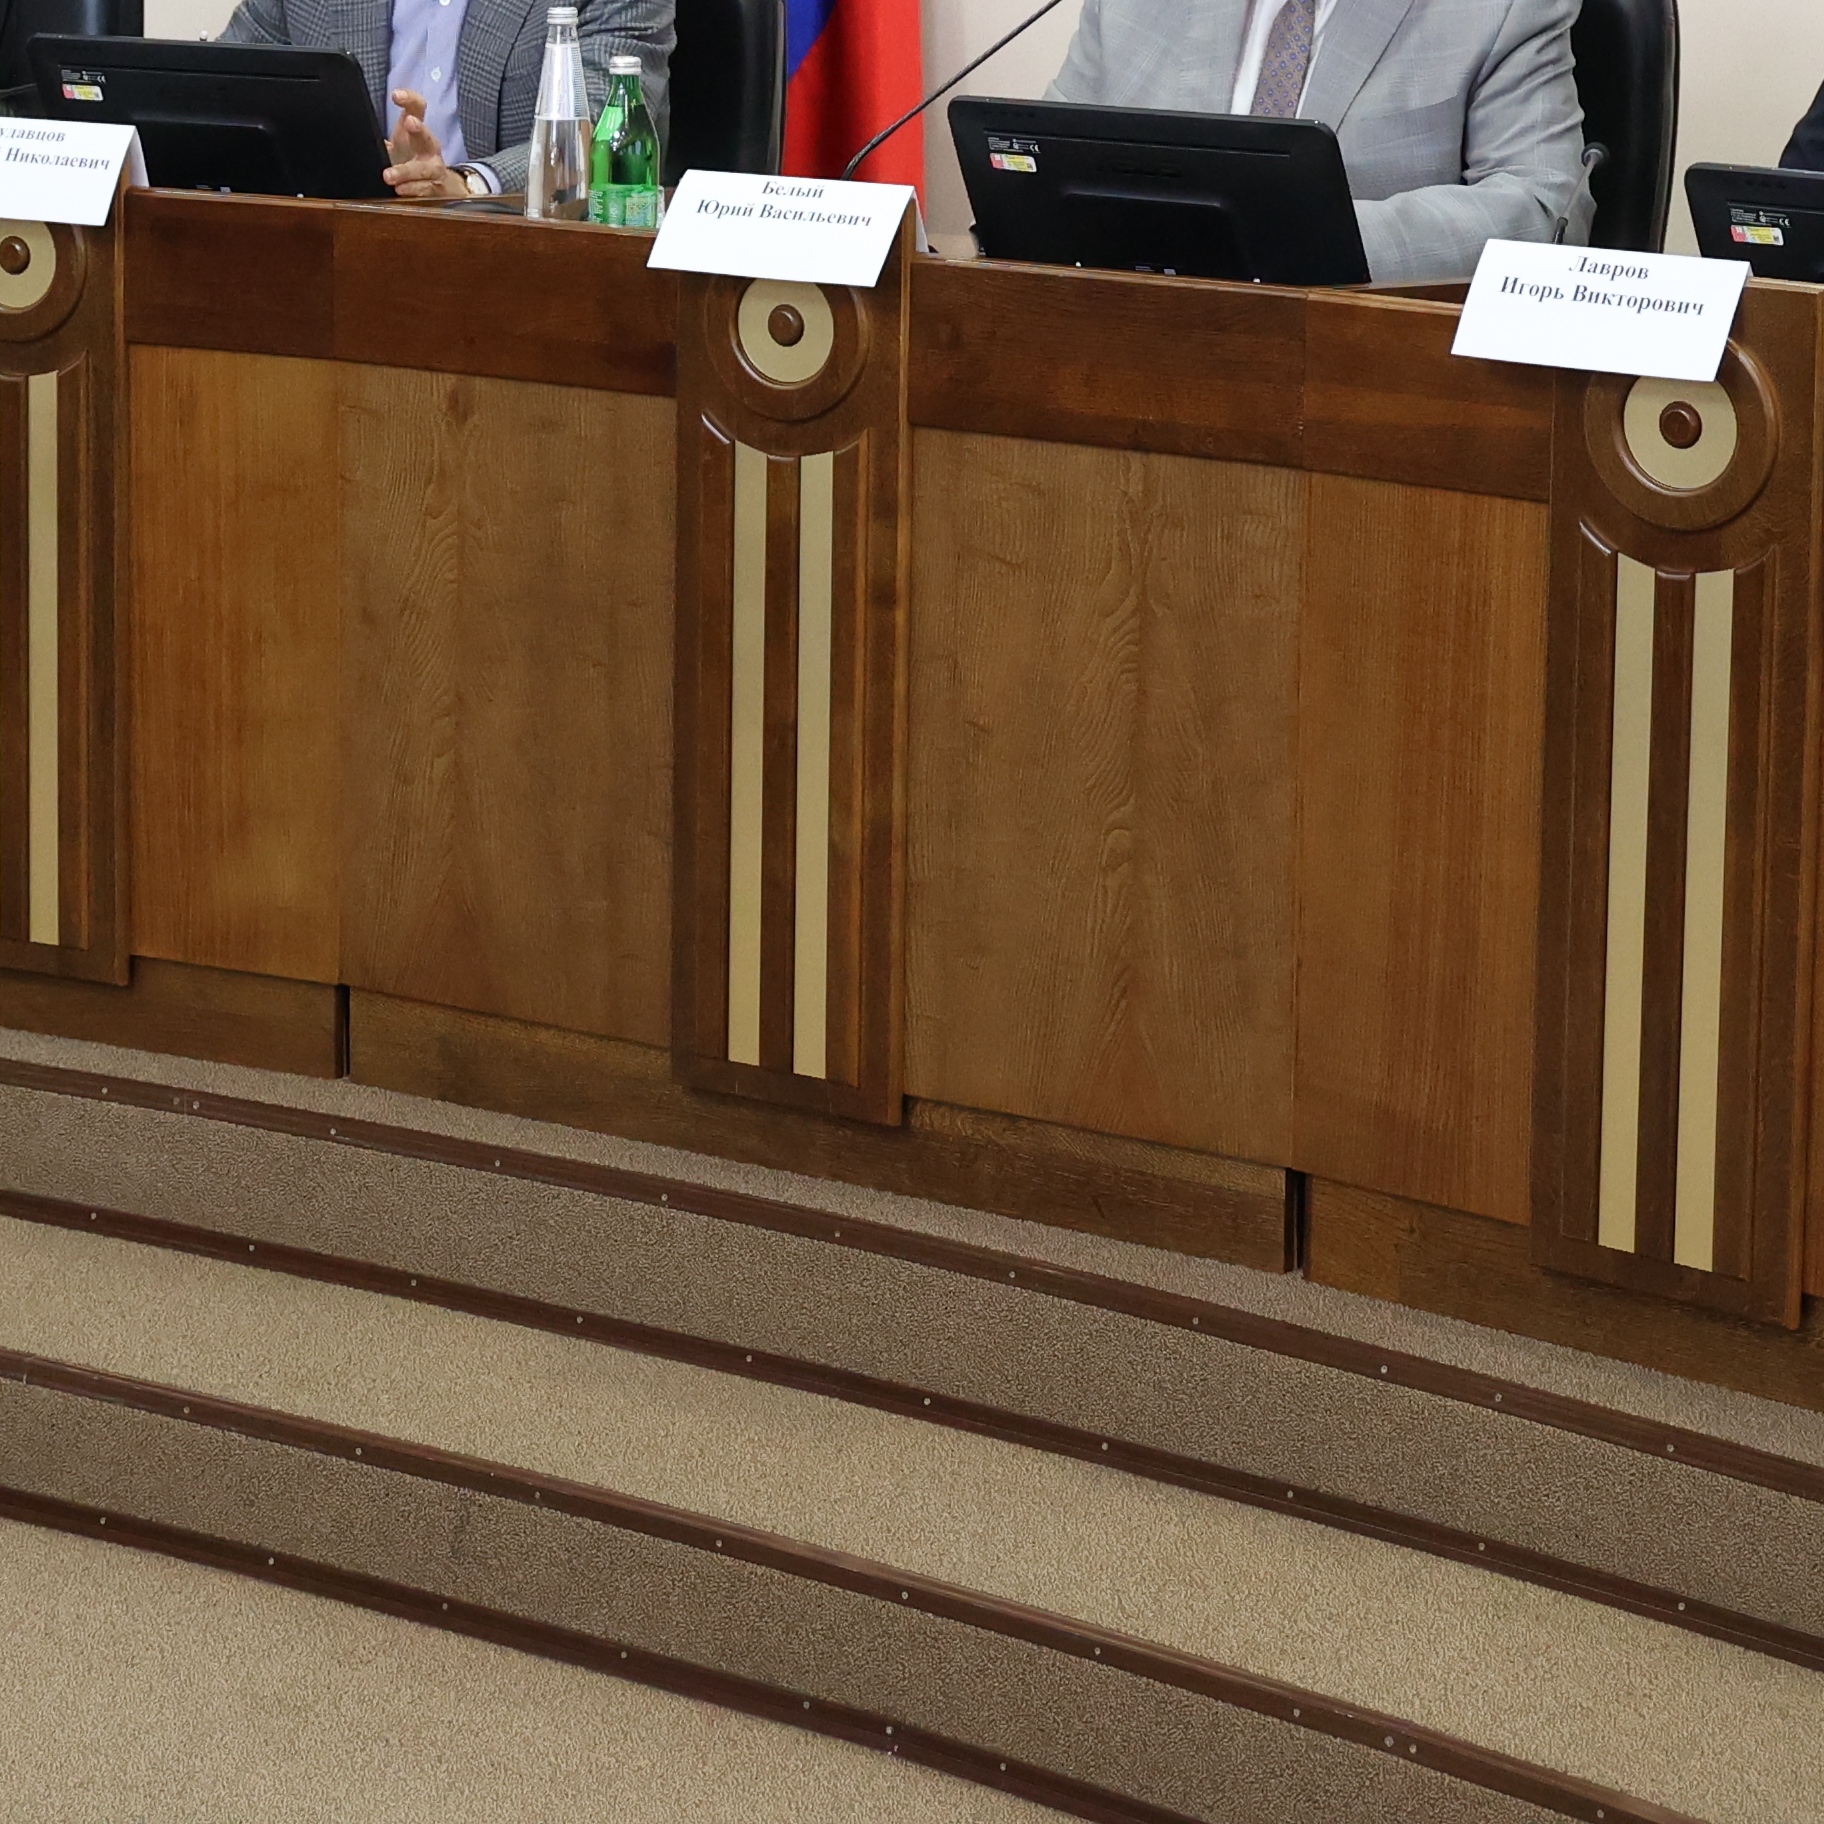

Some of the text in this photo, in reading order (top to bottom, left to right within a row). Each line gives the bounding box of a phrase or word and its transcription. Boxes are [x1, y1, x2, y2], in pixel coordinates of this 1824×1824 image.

[4, 147, 110, 171] Николаевич
[761, 180, 825, 199] Белый
[695, 199, 873, 227] Юрий Васильевич
[1568, 256, 1650, 281] Лавров
[1499, 276, 1705, 316] Игорь Викторович
